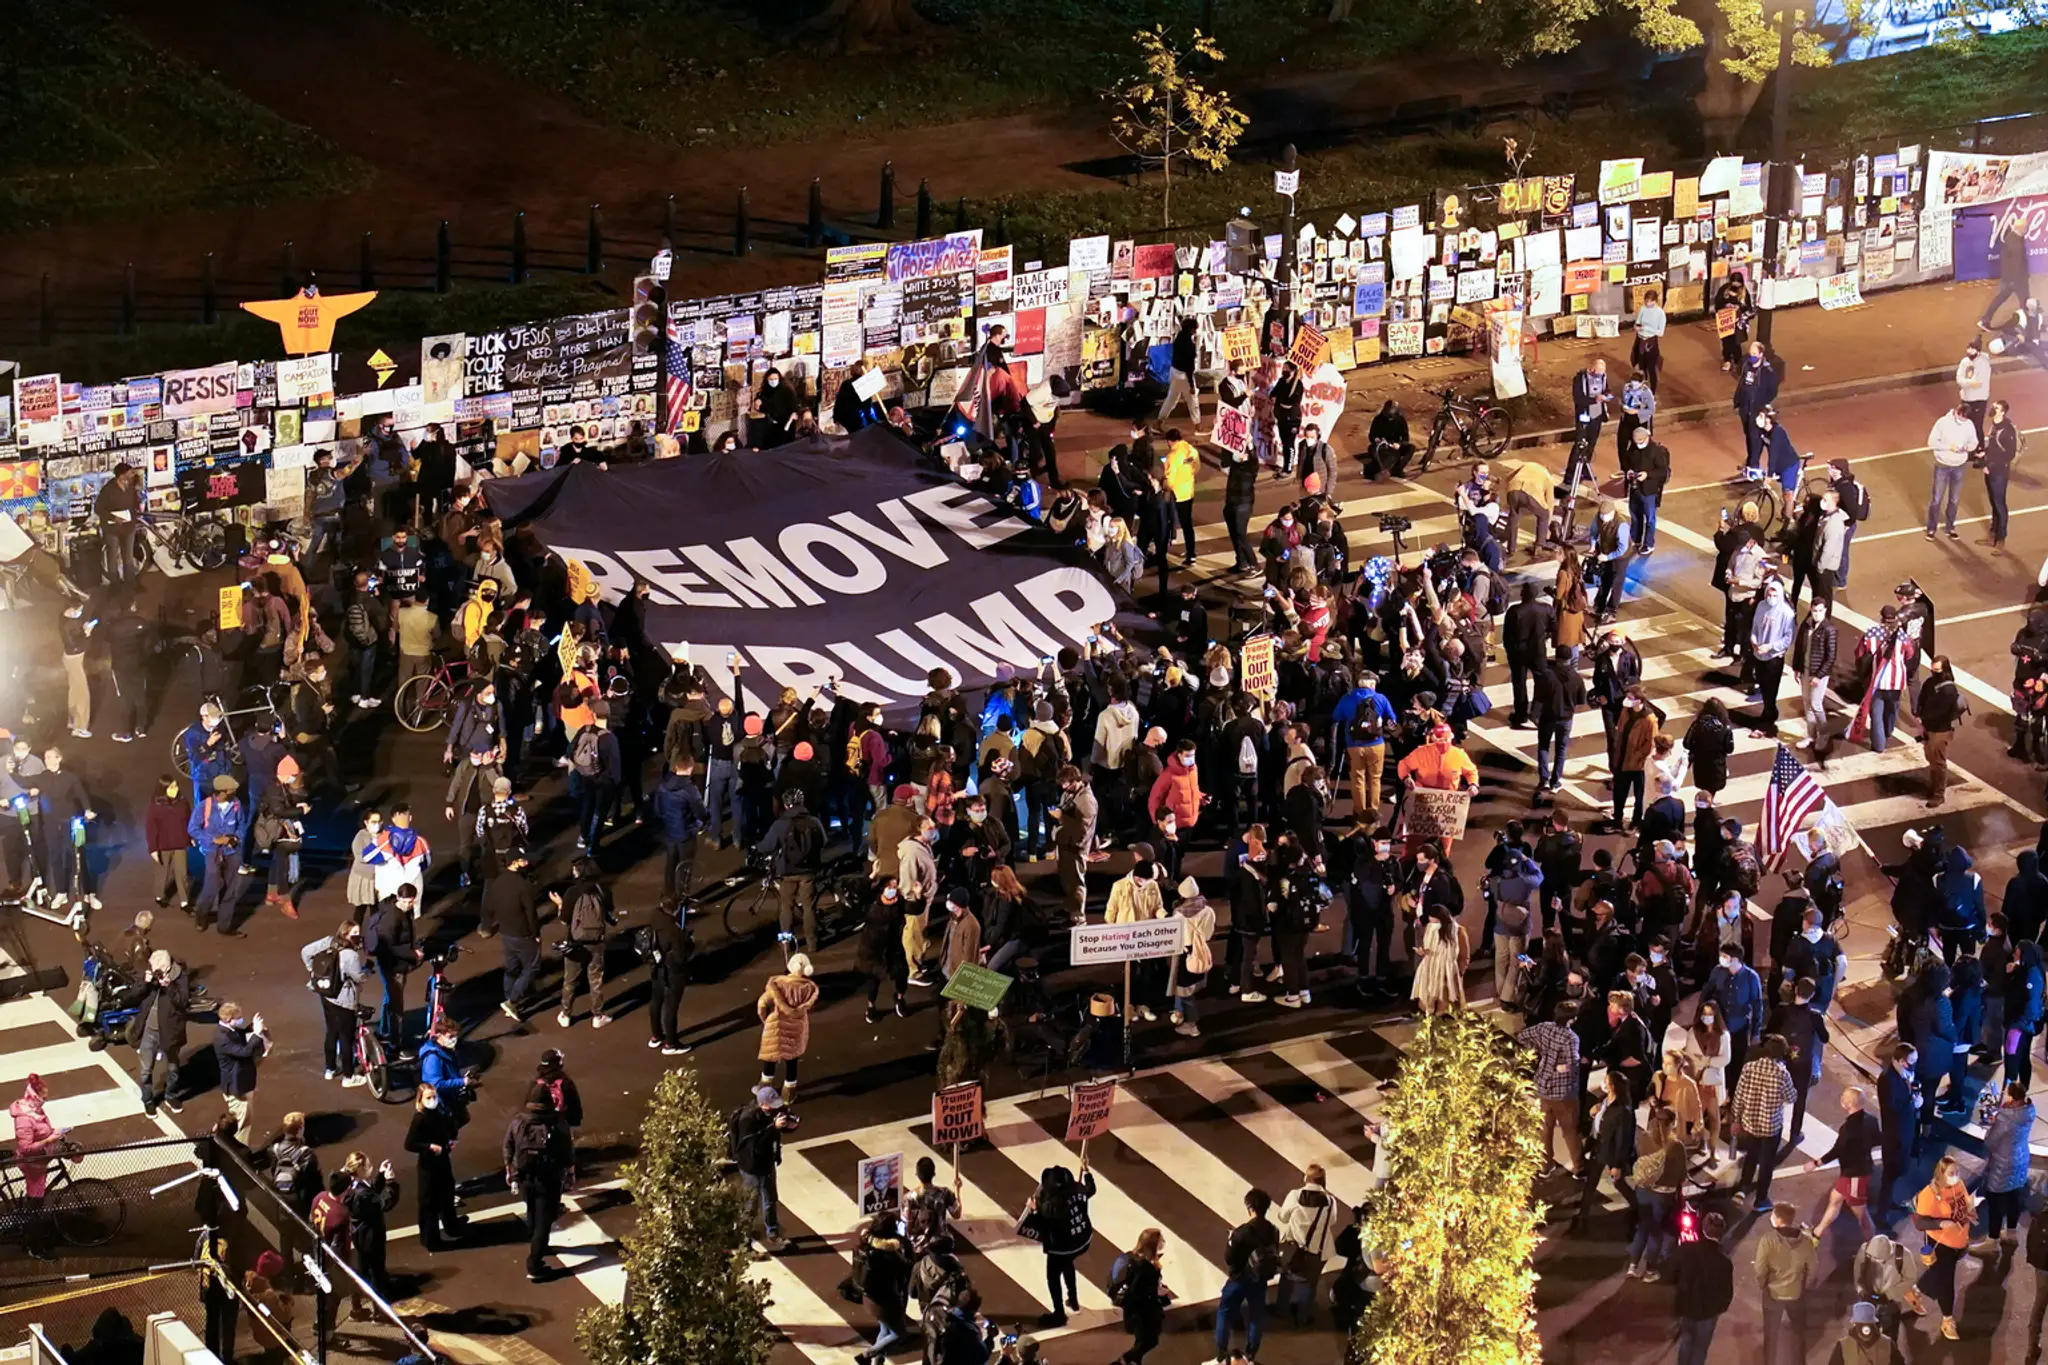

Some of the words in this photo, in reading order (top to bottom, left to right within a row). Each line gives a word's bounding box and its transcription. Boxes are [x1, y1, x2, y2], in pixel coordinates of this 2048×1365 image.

[1501, 181, 1542, 209] BLM
[1016, 271, 1050, 287] BLACK
[1623, 271, 1667, 286] LISTEN
[904, 280, 931, 295] WHITE
[1015, 284, 1043, 297] TRANS
[1045, 279, 1068, 292] LIVES
[1015, 291, 1061, 309] MATTER
[508, 327, 551, 350] JESUS
[1389, 325, 1411, 338] SAY
[465, 332, 507, 357] FUCK
[526, 346, 553, 361] NEED
[559, 342, 591, 358] MORE
[596, 334, 623, 350] THAN
[1230, 344, 1252, 359] OUT
[1298, 343, 1318, 360] OUT
[1389, 344, 1421, 356] NAMES
[295, 358, 318, 371] JOIN
[464, 354, 506, 377] YOUR
[1289, 350, 1317, 375] NOW!
[464, 373, 505, 397] FENCE
[602, 374, 630, 386] TRUMP
[632, 372, 658, 383] REMOVE
[634, 380, 657, 390] TRUMP
[165, 371, 236, 406] RESIST
[601, 386, 610, 396] IS
[611, 383, 630, 395] SICK
[513, 407, 538, 419] TRUMP
[79, 432, 112, 443] REMOVE
[115, 428, 146, 438] REMOVE
[1216, 428, 1246, 453] VOTES
[85, 441, 107, 452] HATE
[118, 436, 144, 446] TRUMP
[178, 439, 208, 450] ARREST
[180, 446, 208, 459] TRUMP
[206, 488, 239, 499] MATTER
[547, 482, 1033, 608] REMOVE
[660, 566, 1121, 719] TRUMP
[1248, 660, 1268, 676] OUT
[1244, 673, 1273, 690] NOW!
[1446, 794, 1466, 804] RIDE
[1427, 804, 1456, 815] RUSSIA
[1079, 935, 1100, 944] Stop
[1101, 932, 1130, 942] Hating
[1132, 930, 1152, 939] Each
[1154, 926, 1178, 937] Other
[1083, 944, 1118, 955] Because
[1120, 943, 1135, 951] You
[1137, 939, 1174, 951] Disagree
[942, 1101, 975, 1113] Pence
[1077, 1101, 1107, 1112] Pence
[943, 1110, 974, 1127] OUT
[936, 1124, 979, 1142] NOW!
[1077, 1124, 1096, 1136] YA!
[866, 1200, 891, 1213] VOT
[1021, 1225, 1040, 1240] VOT
